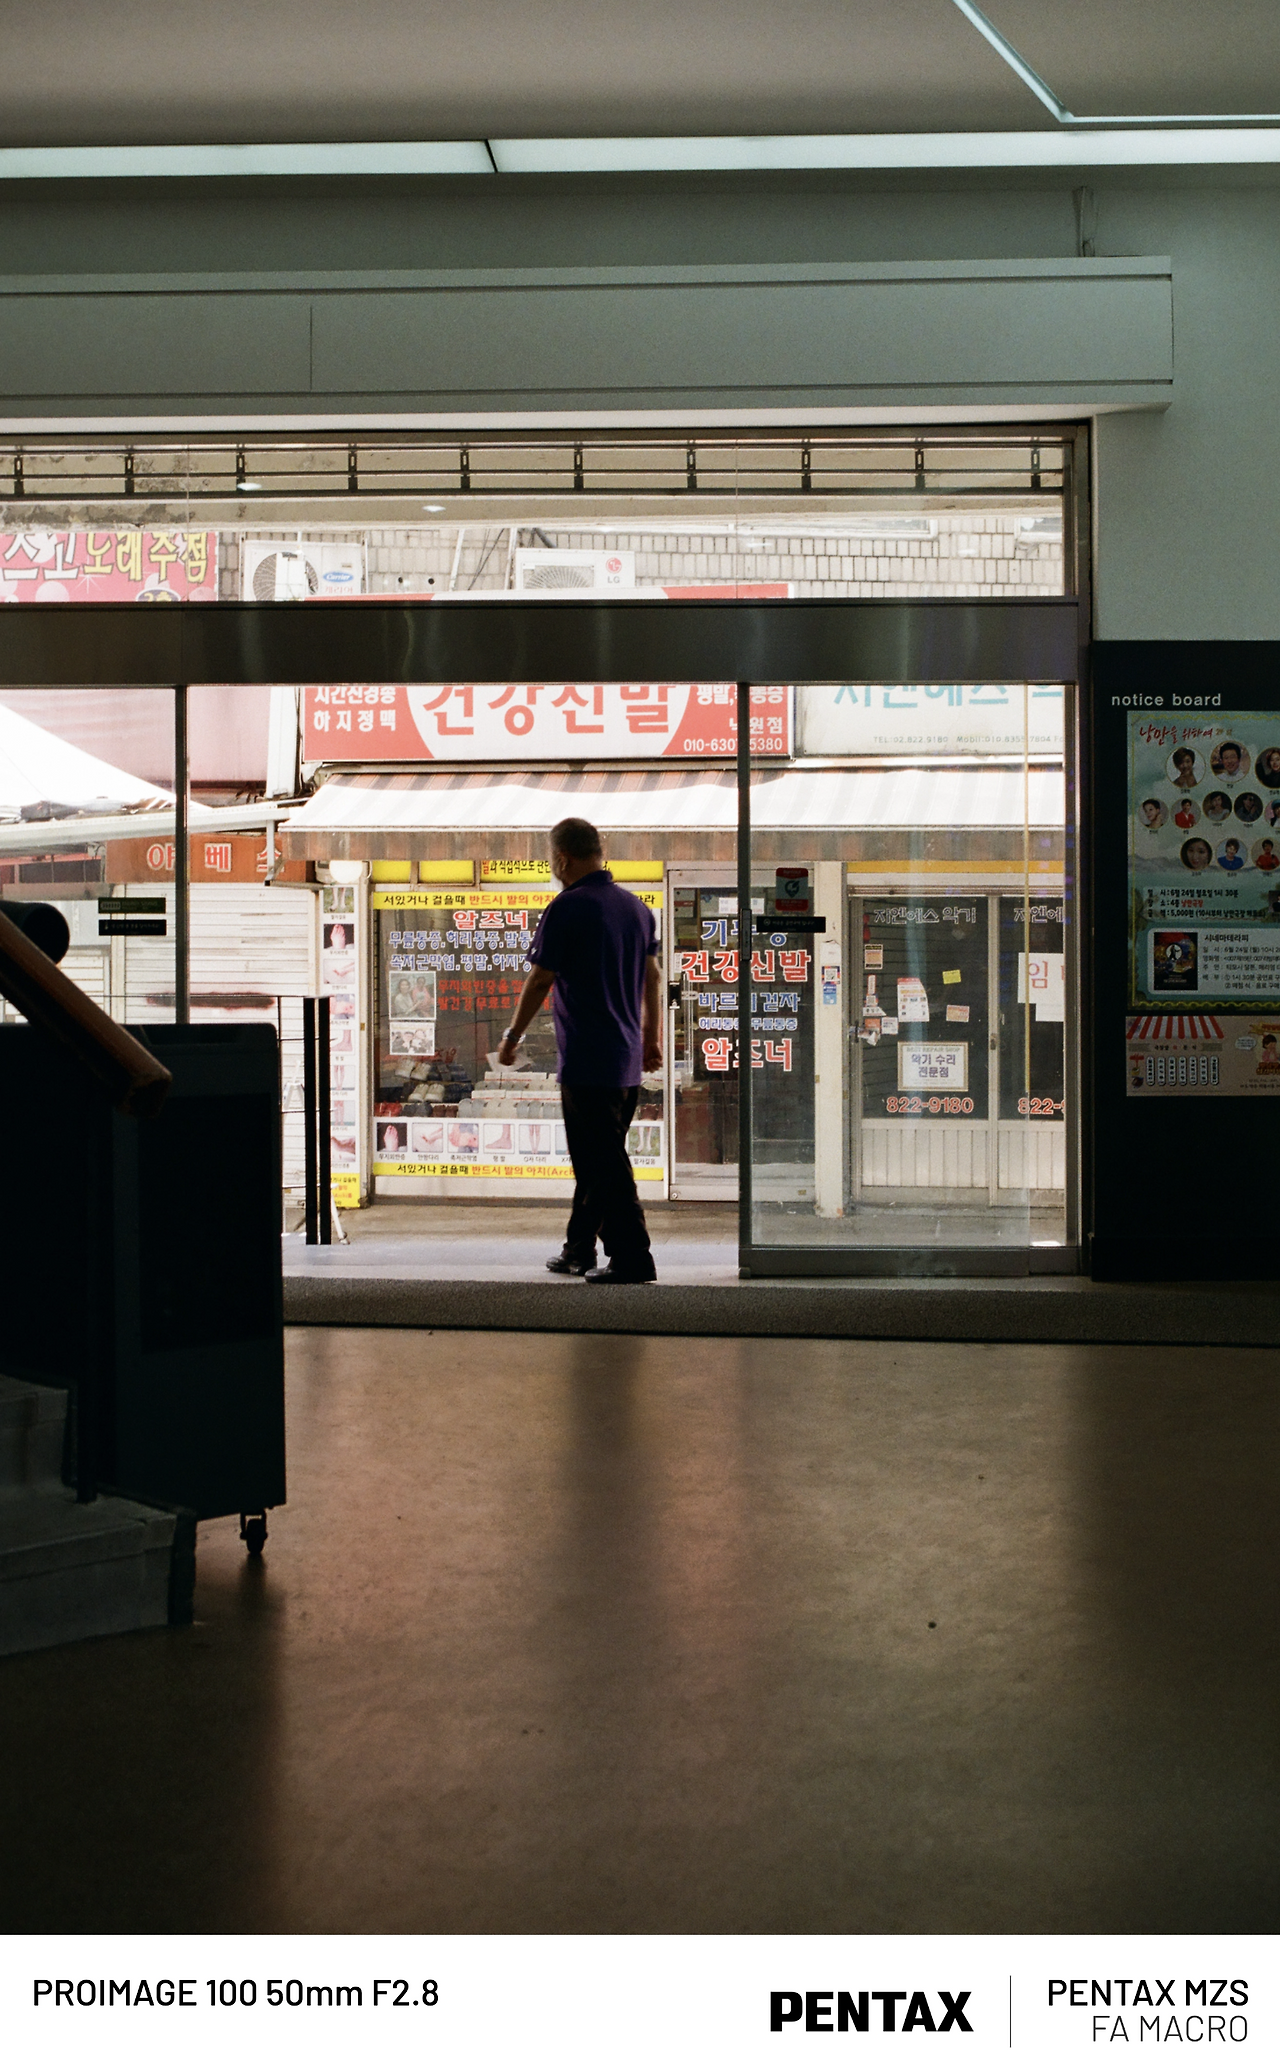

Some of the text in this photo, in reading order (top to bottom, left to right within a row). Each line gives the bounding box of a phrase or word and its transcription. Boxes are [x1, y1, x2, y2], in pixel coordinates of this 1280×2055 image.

[607, 576, 620, 584] LG
[1111, 693, 1221, 706] notice board
[423, 686, 677, 736] 건강신발
[314, 710, 396, 732] 하지정맥
[1139, 723, 1178, 746] 낭만을
[1181, 727, 1214, 741] 위하여
[384, 894, 430, 906] 서있거나
[432, 895, 466, 906] 걸을때
[469, 895, 503, 906] 반드시
[506, 895, 529, 906] 발의
[453, 910, 529, 930] 알즈너
[942, 906, 977, 924] 악기
[1204, 934, 1249, 942] 시네마테라피
[681, 950, 812, 983] 건강신발
[759, 992, 801, 1012] 걷자
[935, 1053, 956, 1065] 수리
[918, 1066, 949, 1078] 전문점
[886, 1096, 974, 1114] 822-9180
[397, 1164, 437, 1175] 서있거나
[440, 1165, 469, 1175] 걸을때
[471, 1165, 501, 1176] 반드시
[504, 1166, 524, 1176] 발의
